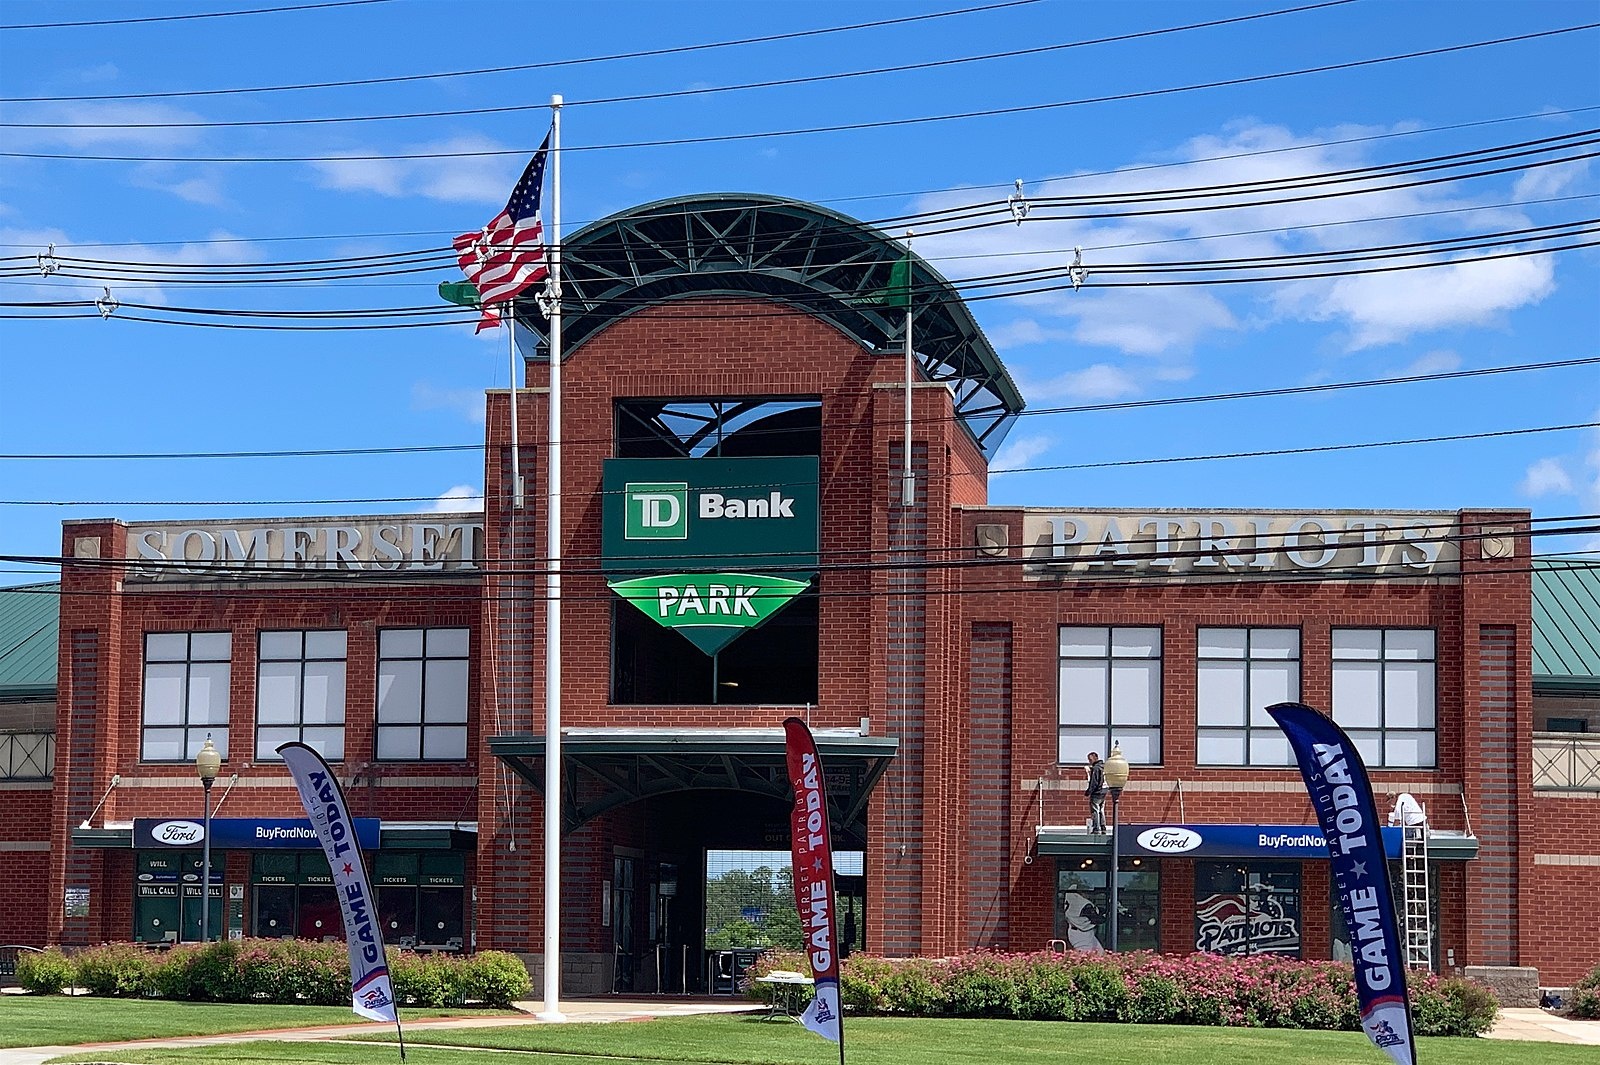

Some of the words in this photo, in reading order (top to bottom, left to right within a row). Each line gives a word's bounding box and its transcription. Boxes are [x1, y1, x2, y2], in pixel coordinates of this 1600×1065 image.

[632, 494, 681, 527] TD
[700, 492, 795, 518] Bank
[1046, 515, 1435, 569] PATRIOTS
[136, 523, 484, 576] SOMERSET
[658, 585, 760, 617] PARK
[307, 770, 351, 859] TODAY
[794, 778, 808, 854] PATRIOTS
[802, 753, 824, 851] TODAY
[1311, 772, 1340, 858] PATRIOTS
[1312, 743, 1367, 855] TODAY
[162, 824, 197, 841] Ford
[1149, 831, 1190, 849] Ford
[141, 886, 157, 895] WILL
[158, 886, 175, 895] CALL
[186, 887, 202, 895] WILL
[344, 881, 379, 963] GAME
[810, 880, 831, 972] GAME
[1350, 886, 1391, 991] GAME
